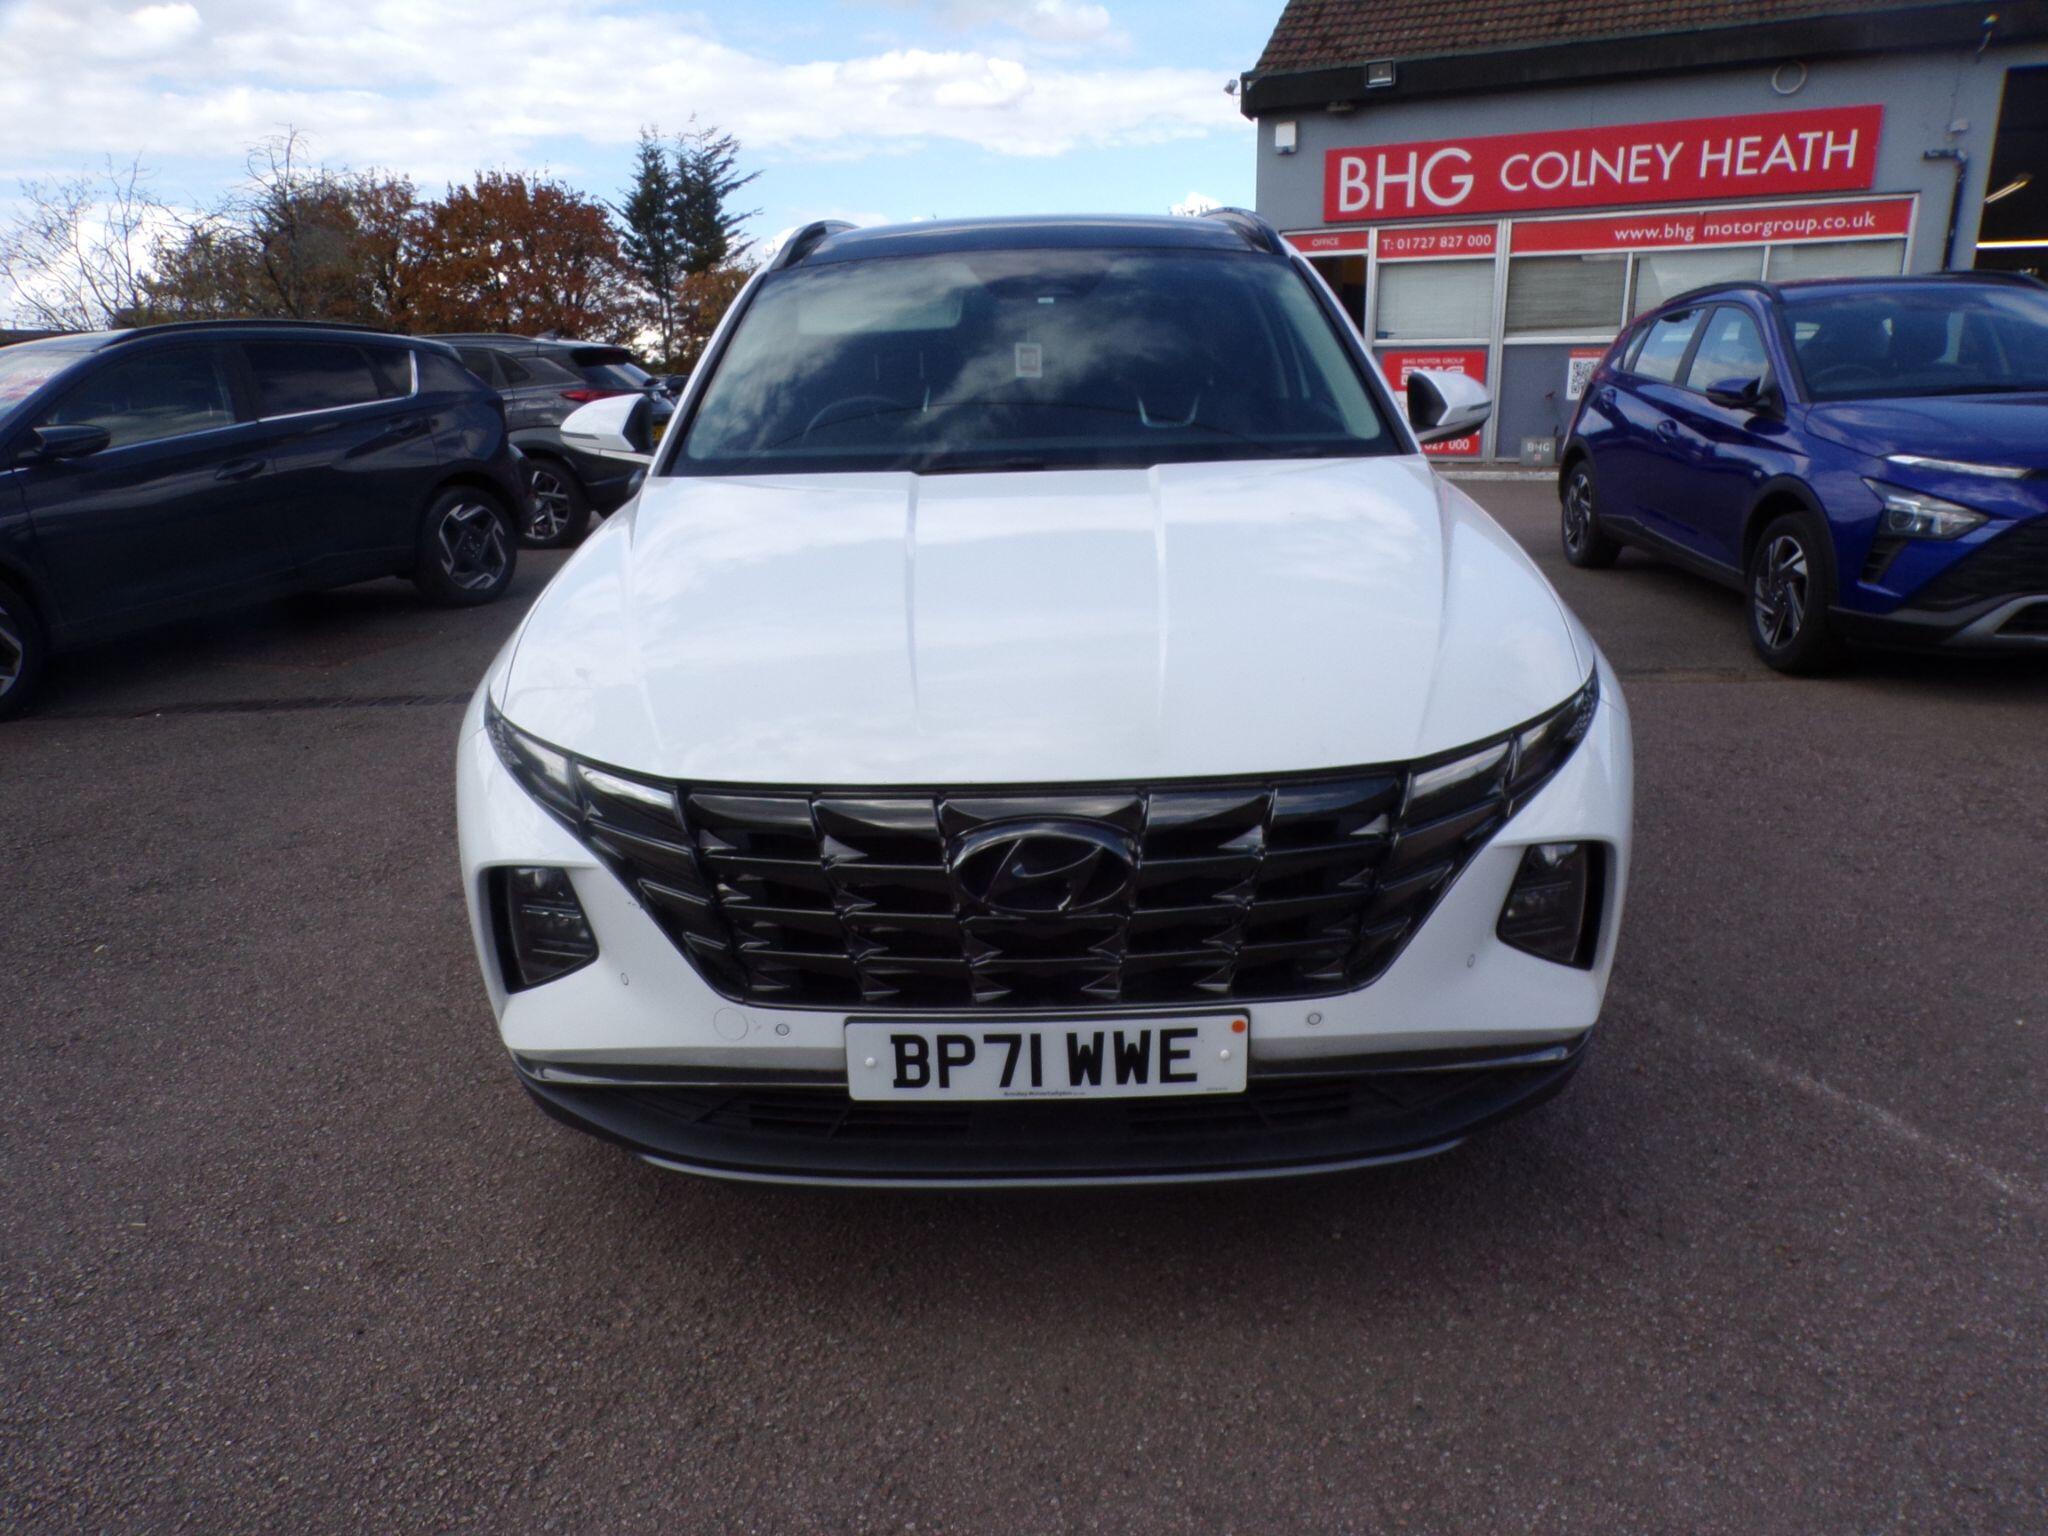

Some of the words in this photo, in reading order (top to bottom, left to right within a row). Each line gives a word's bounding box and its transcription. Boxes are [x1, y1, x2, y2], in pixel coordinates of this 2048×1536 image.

[1338, 147, 1474, 212] BHG
[1500, 142, 1684, 192] COLNEY
[1700, 128, 1859, 179] HEATH
[1614, 222, 1695, 242] www.bhg
[1703, 210, 1876, 238] motorgroup.co.uk
[1311, 236, 1340, 247] OFFICE
[1382, 238, 1395, 251] T:
[1396, 236, 1435, 250] 01727
[1439, 235, 1463, 248] 827
[1467, 233, 1492, 247] 000
[1448, 438, 1470, 450] 000
[1526, 442, 1550, 452] BHG
[890, 1032, 1042, 1089] BP71
[1066, 1027, 1199, 1087] WWE
